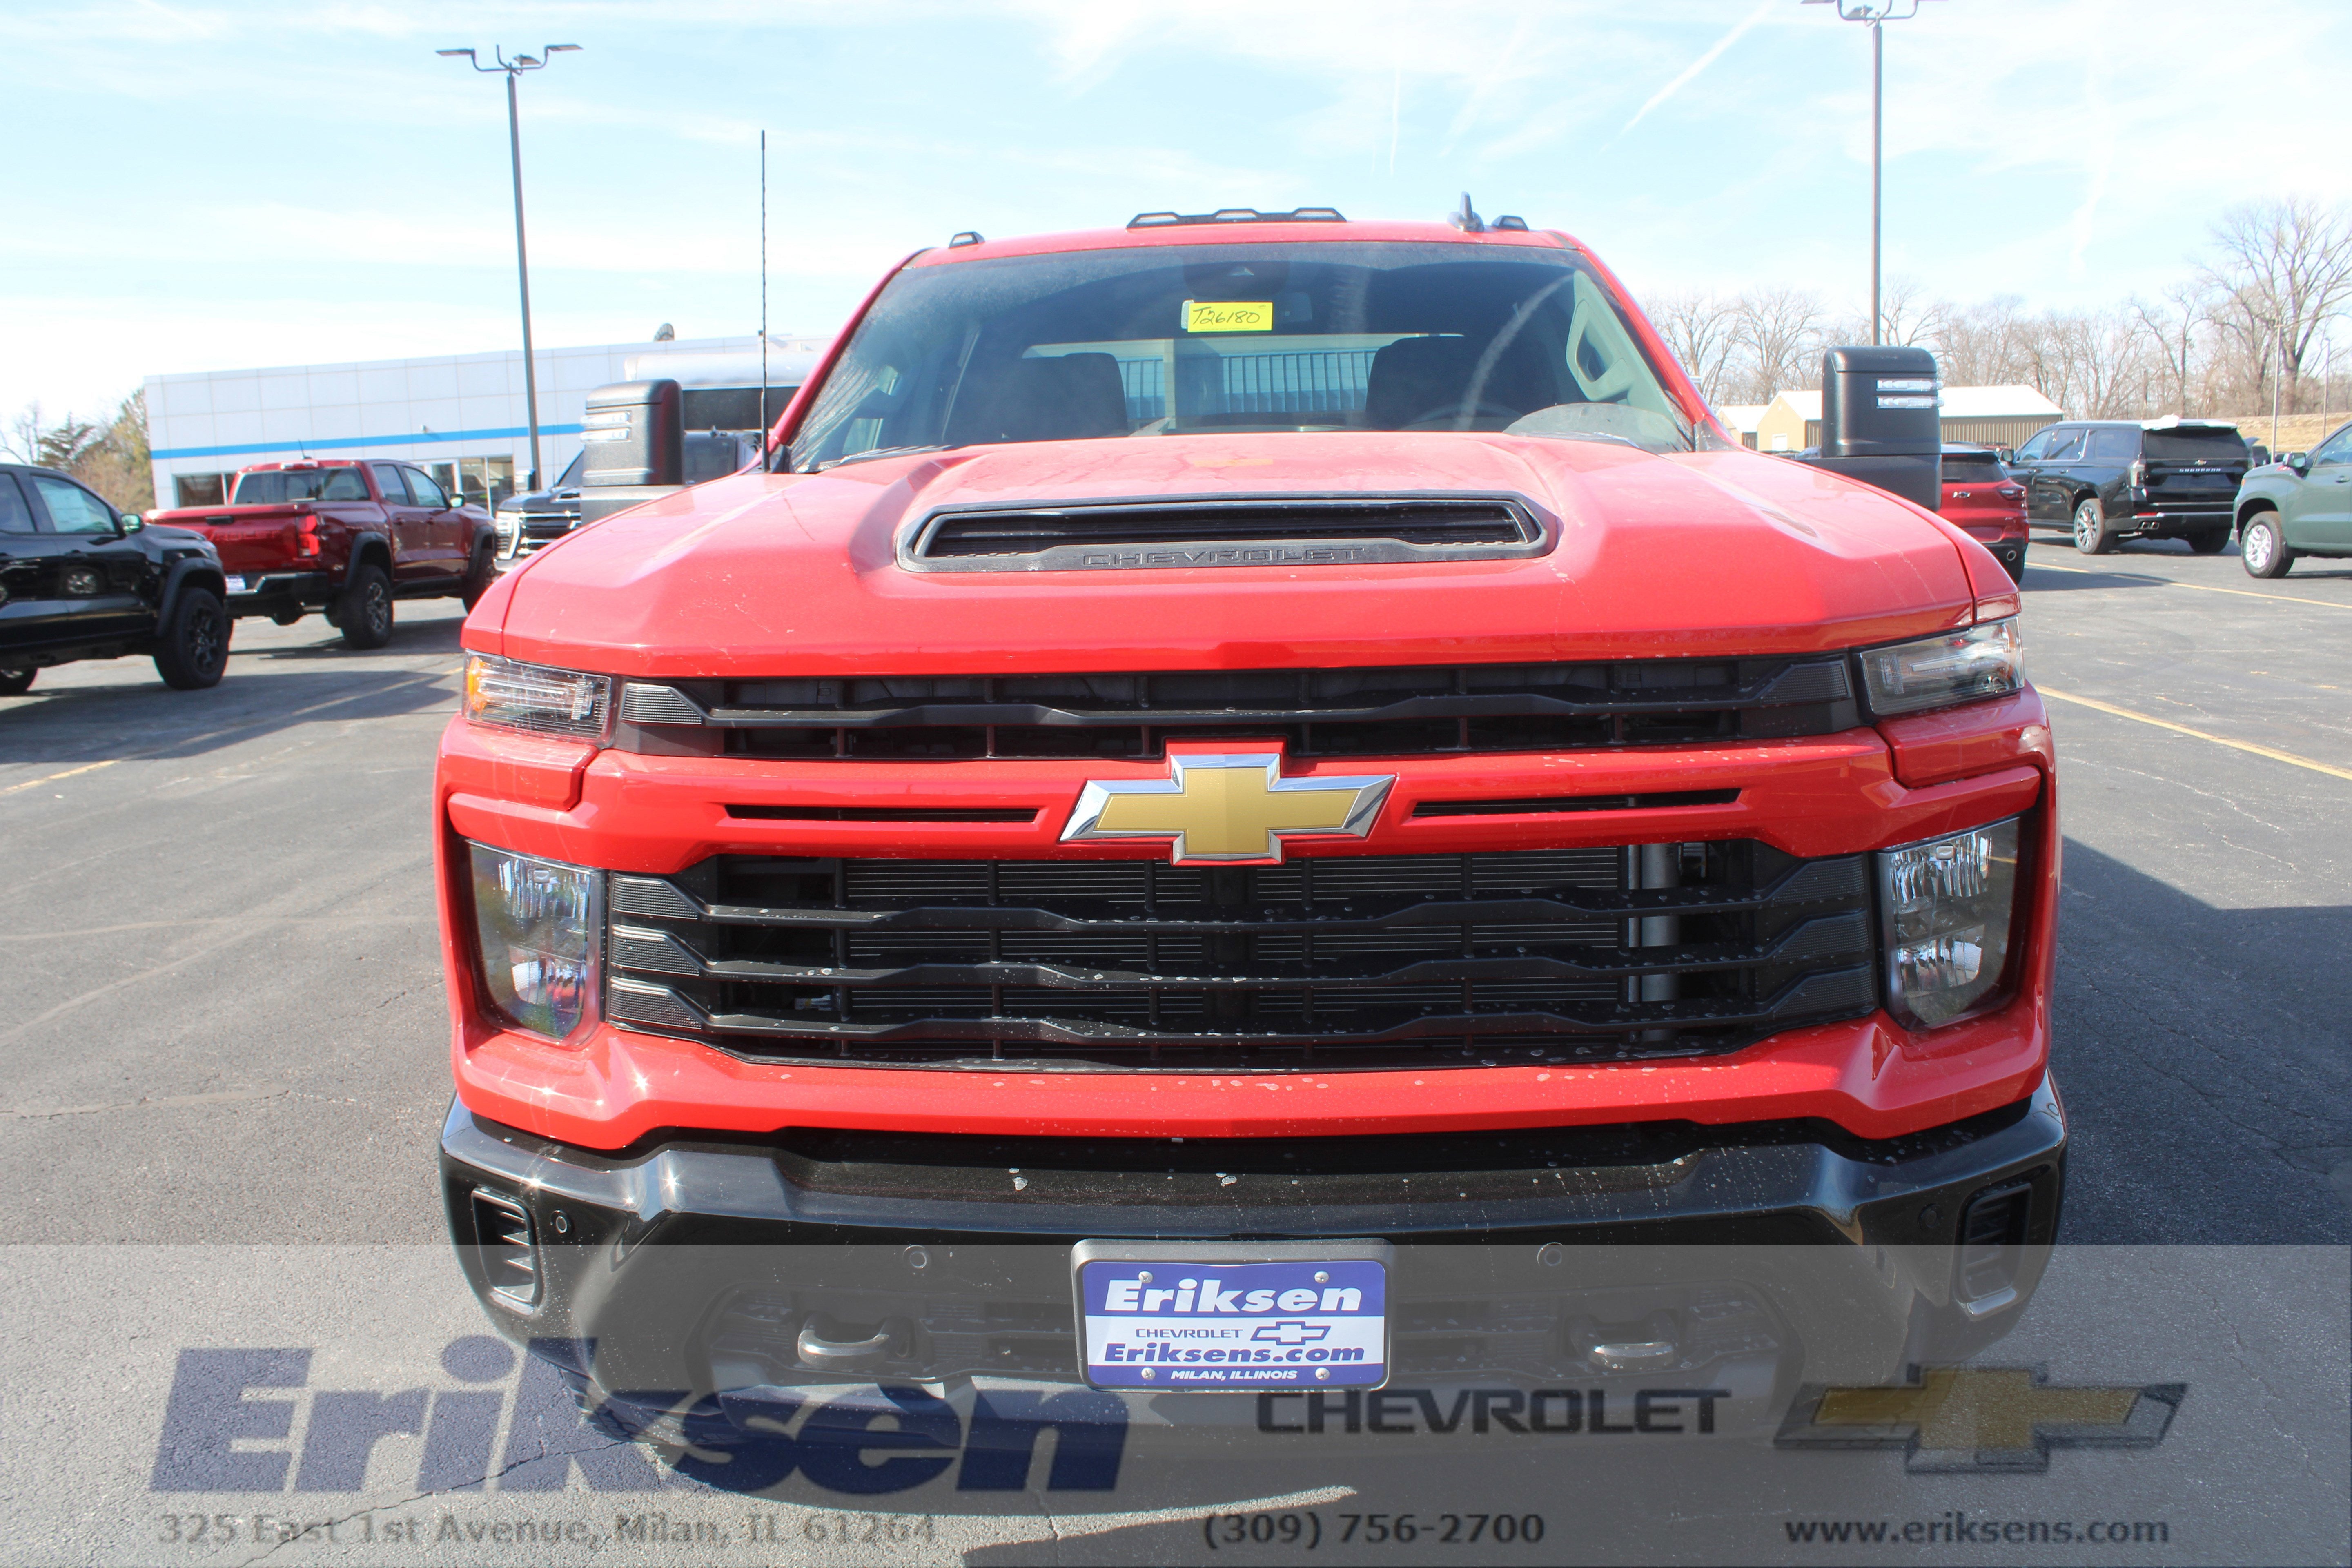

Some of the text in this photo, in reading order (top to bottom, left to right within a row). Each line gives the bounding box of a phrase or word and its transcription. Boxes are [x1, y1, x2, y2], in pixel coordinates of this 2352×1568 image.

[1193, 307, 1260, 325] T26180
[1083, 548, 1365, 566] CHEVROLET
[1104, 1278, 1362, 1312] Eriksen
[1136, 1328, 1243, 1339] CHEVROLET
[1104, 1342, 1365, 1362] Eriksens.com
[1170, 1370, 1298, 1381] MILAN, ILLINOIS
